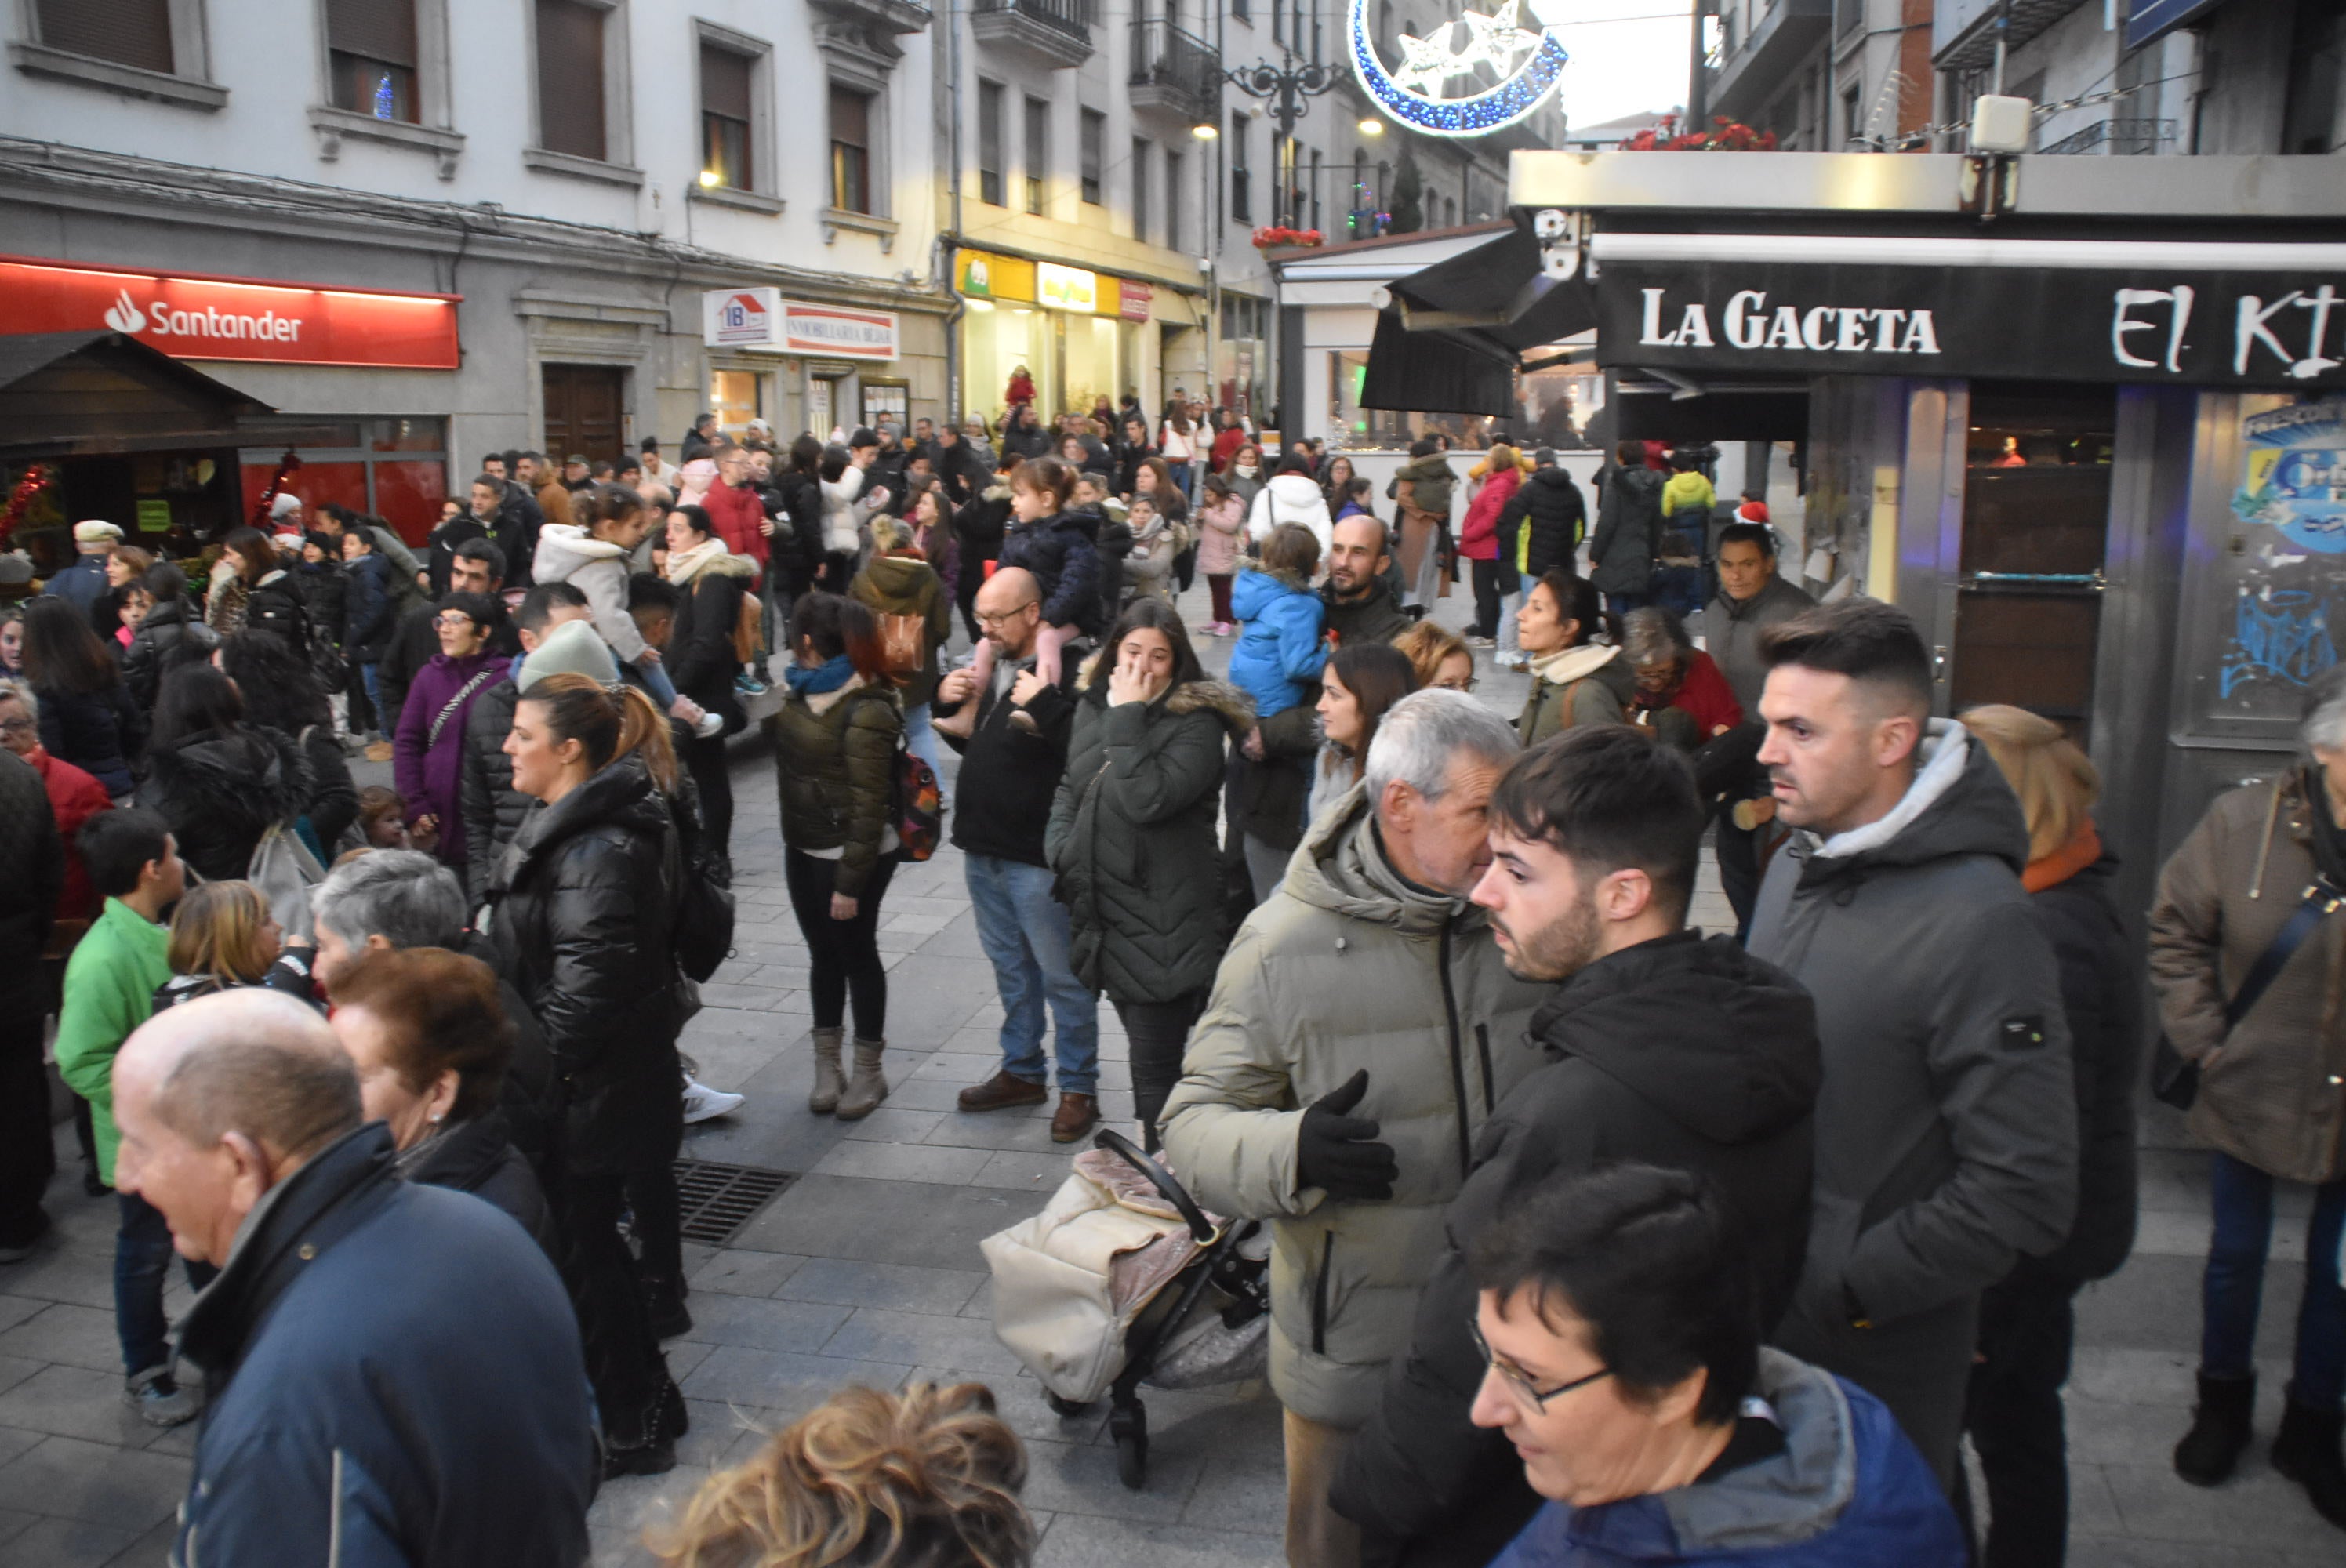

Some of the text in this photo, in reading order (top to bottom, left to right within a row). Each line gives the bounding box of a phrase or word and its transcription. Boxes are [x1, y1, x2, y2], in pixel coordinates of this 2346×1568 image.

[150, 301, 302, 342] Santander
[726, 306, 744, 327] IB
[1639, 288, 1942, 353] LA GACETA
[2233, 285, 2346, 378] KI
